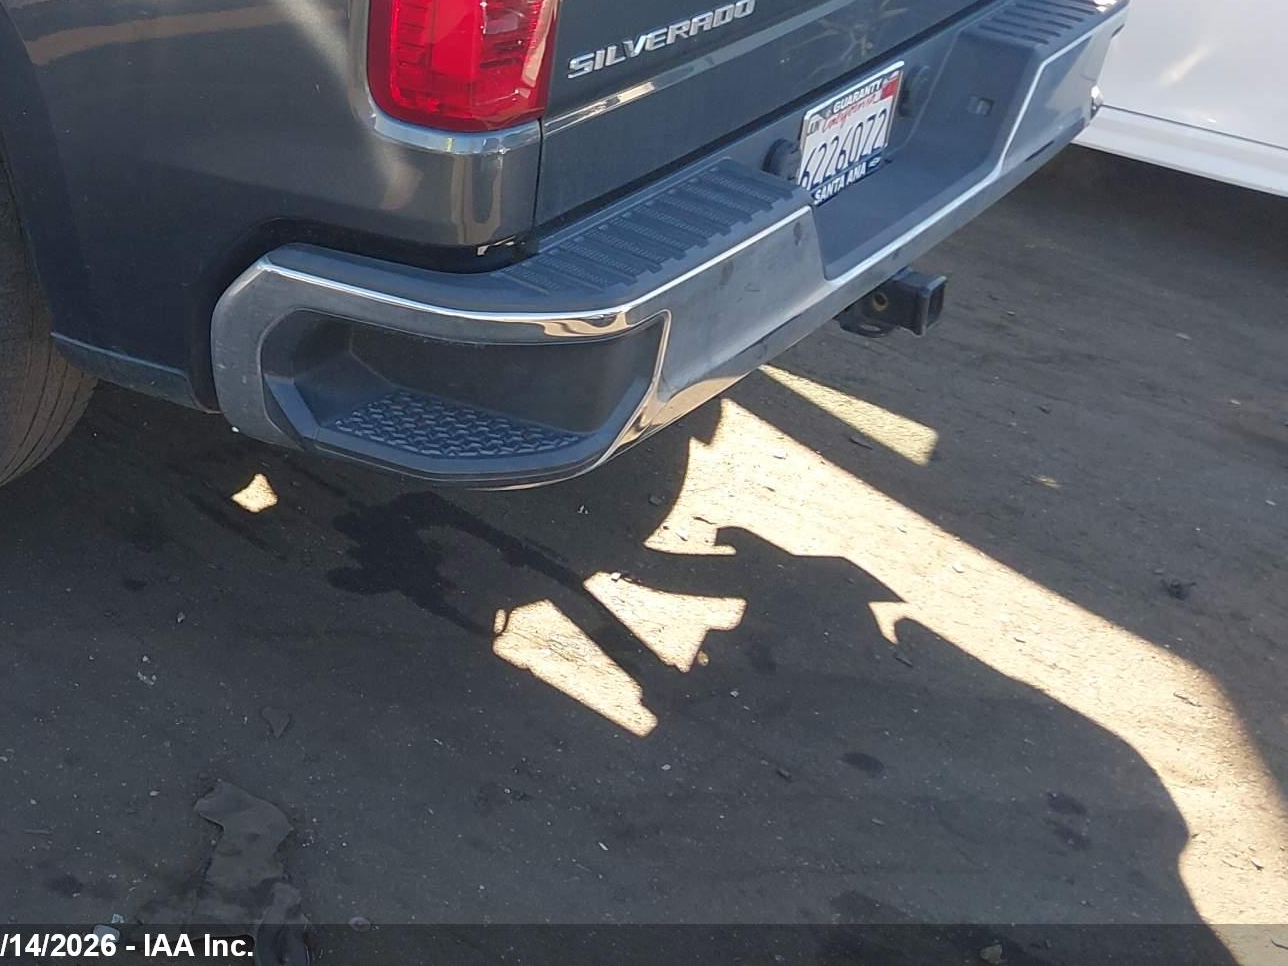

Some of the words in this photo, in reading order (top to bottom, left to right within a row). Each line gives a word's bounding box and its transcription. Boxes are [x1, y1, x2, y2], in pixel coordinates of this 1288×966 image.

[833, 78, 882, 113] GUARANTY
[814, 174, 845, 205] SANTA
[847, 161, 867, 185] ANA
